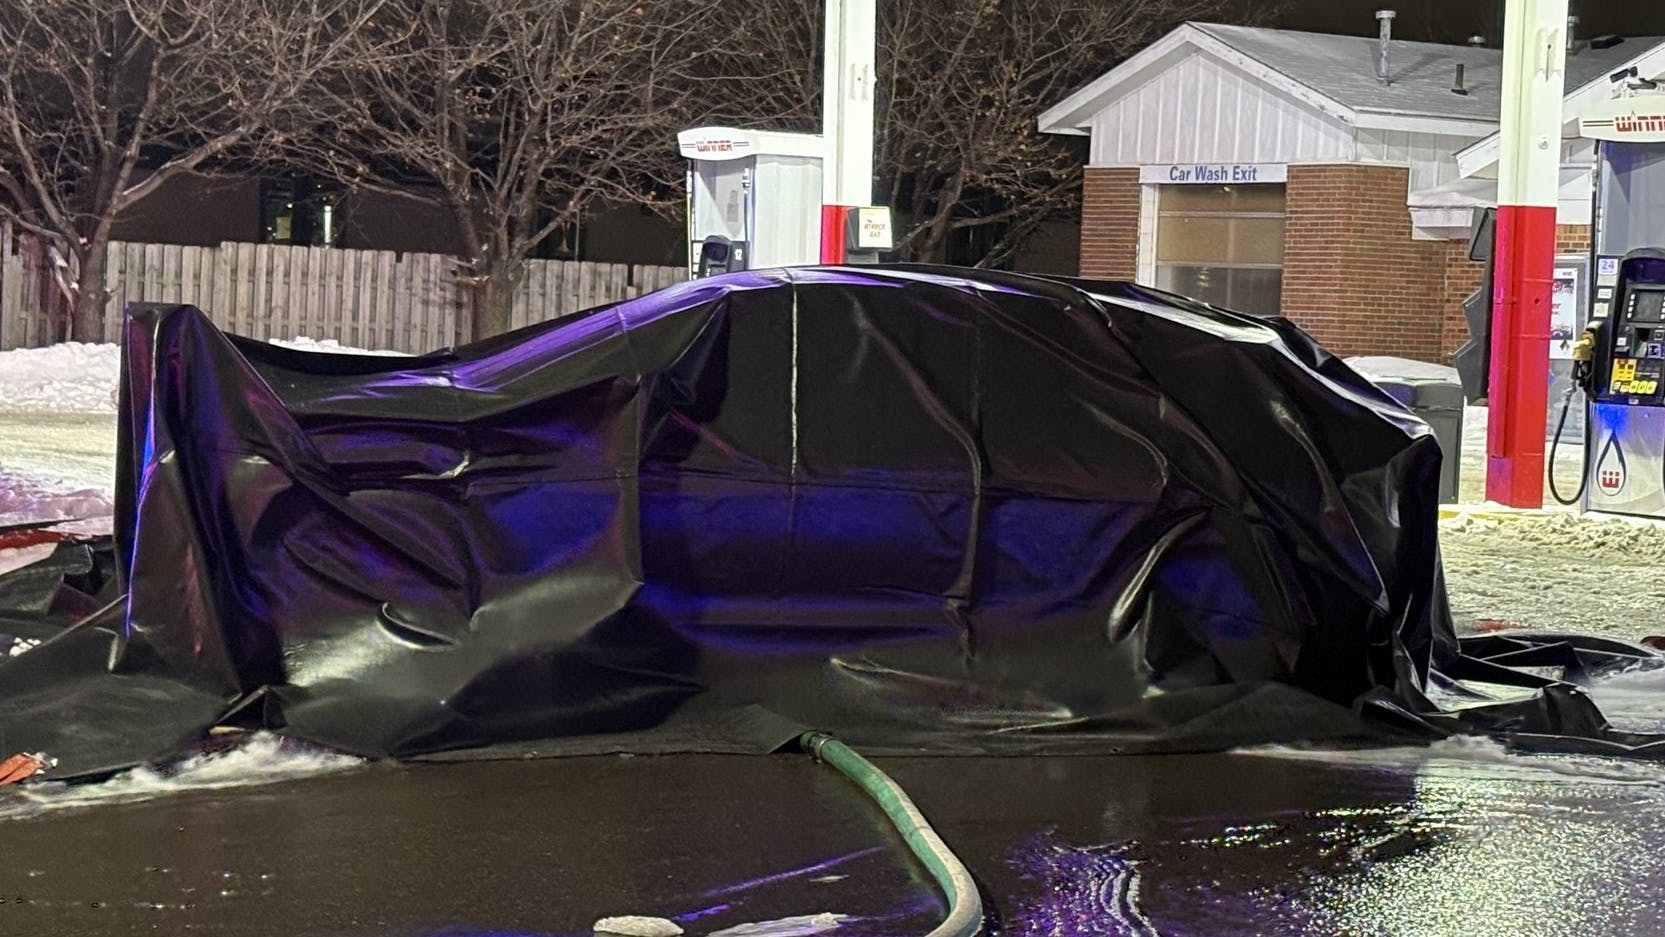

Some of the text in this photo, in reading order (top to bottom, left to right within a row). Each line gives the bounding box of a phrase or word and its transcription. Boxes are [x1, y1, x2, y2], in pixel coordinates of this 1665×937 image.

[1169, 165, 1258, 181] Car Wash Exit
[1601, 260, 1615, 270] 24
